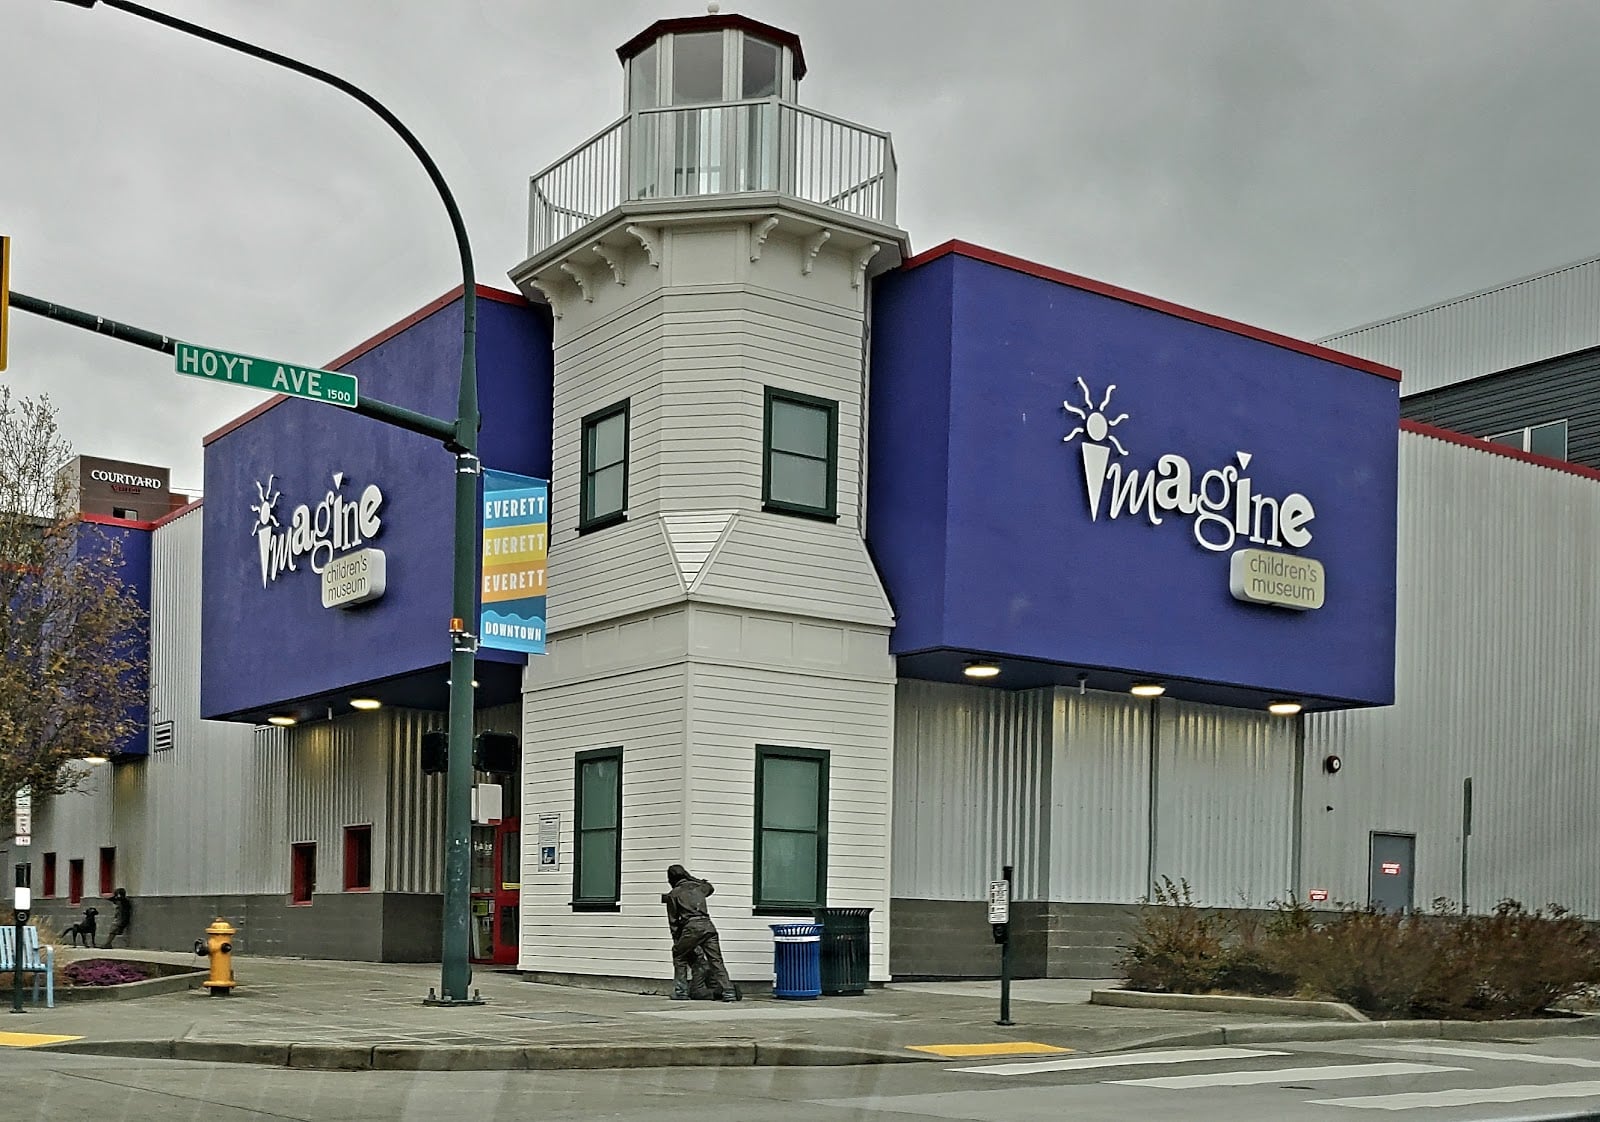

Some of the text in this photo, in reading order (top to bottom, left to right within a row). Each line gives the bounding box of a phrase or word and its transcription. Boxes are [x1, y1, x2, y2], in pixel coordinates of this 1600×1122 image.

[182, 347, 351, 402] HOYT AVE 1500
[91, 469, 161, 489] COURTYARD
[1082, 412, 1315, 551] imagine
[485, 497, 545, 520] EVERETT
[257, 472, 383, 589] imagine
[485, 533, 545, 557] EVERETT
[326, 555, 368, 584] children's
[1250, 554, 1318, 583] children's
[328, 576, 366, 601] museum
[484, 569, 545, 593] EVERETT
[1252, 577, 1315, 601] museum
[485, 620, 542, 642] DOWNTOWN
